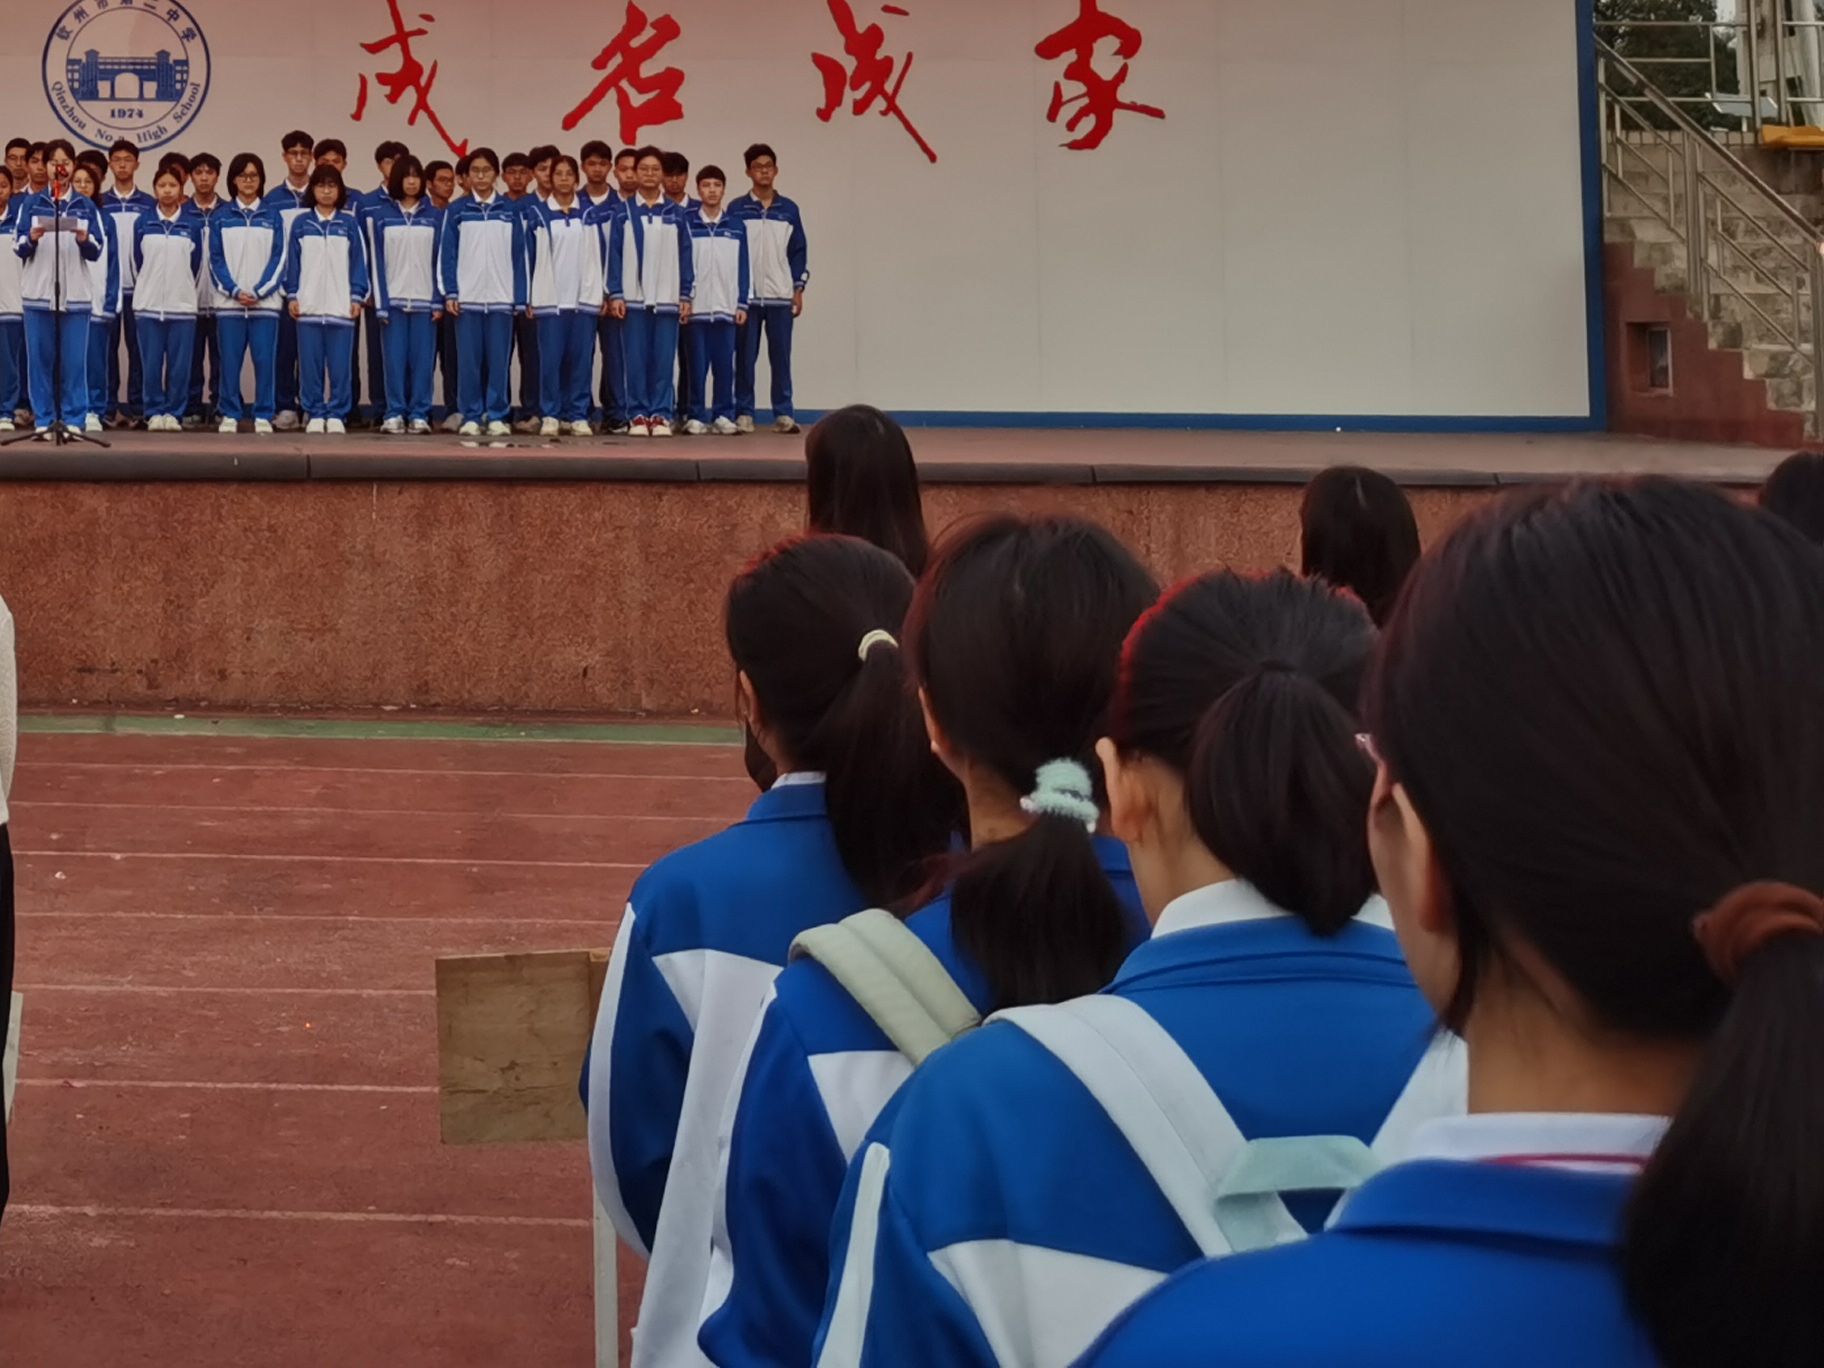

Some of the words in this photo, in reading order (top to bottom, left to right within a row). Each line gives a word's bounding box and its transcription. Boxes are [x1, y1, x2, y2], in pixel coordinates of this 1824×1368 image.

[51, 80, 87, 131] Qinzhou
[136, 124, 168, 143] High
[172, 81, 201, 124] School
[108, 108, 145, 120] 1974
